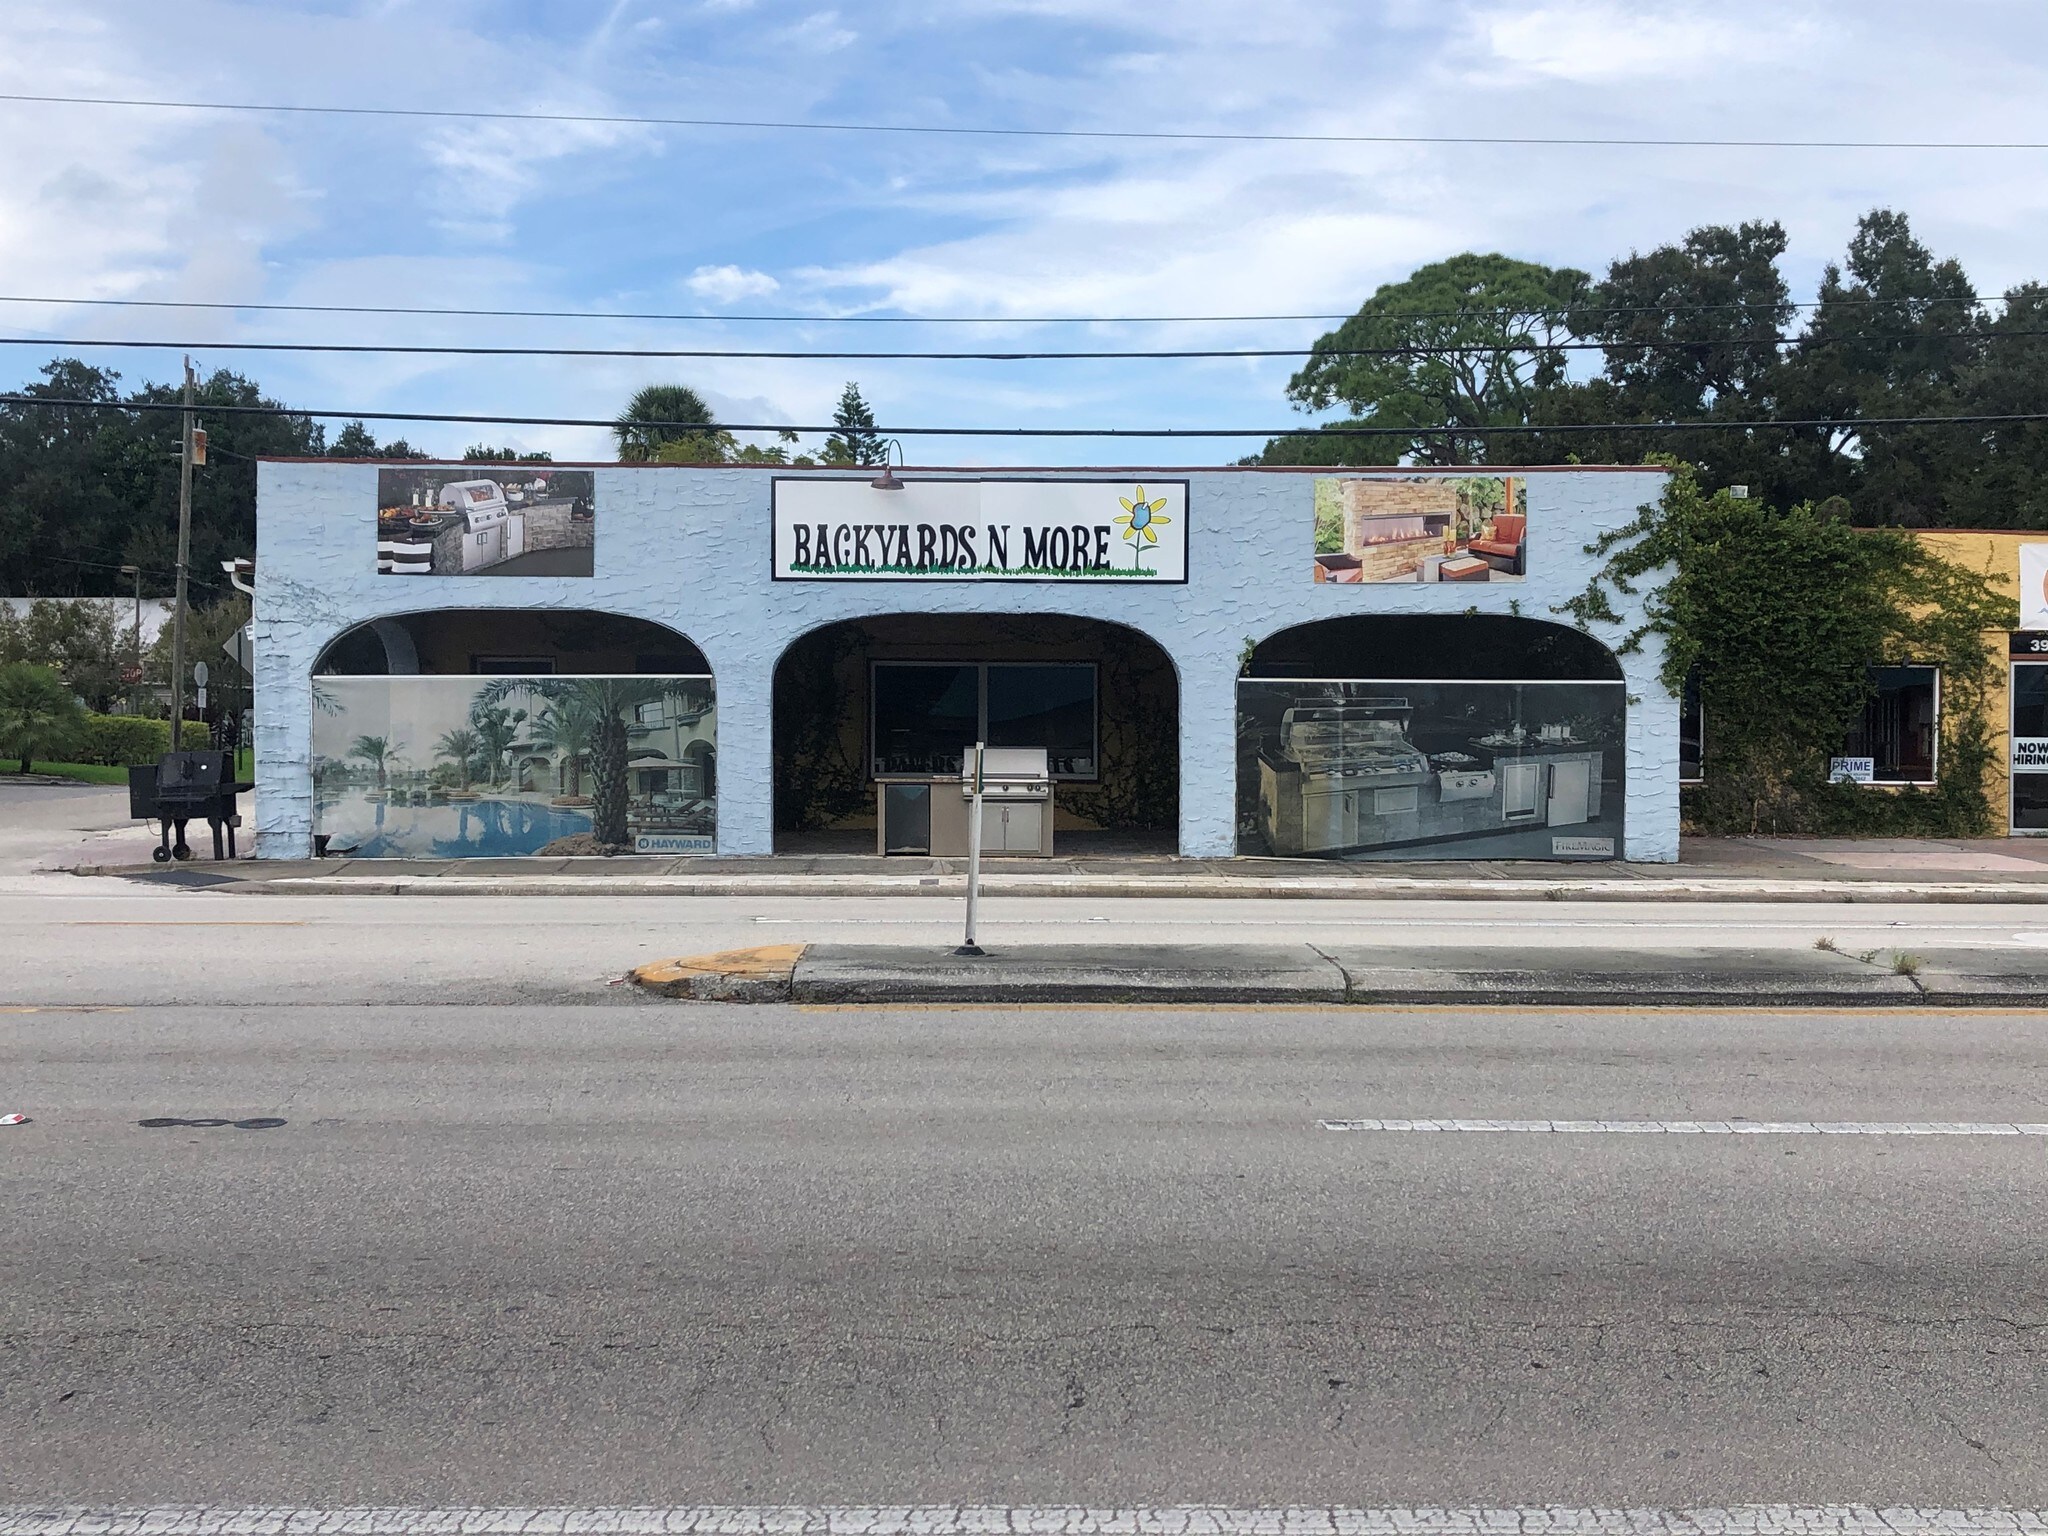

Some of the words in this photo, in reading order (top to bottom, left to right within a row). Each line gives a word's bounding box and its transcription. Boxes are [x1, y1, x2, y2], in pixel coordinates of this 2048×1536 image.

[793, 523, 977, 570] BACKYARDS
[986, 525, 1010, 570] N
[1021, 525, 1111, 570] MORE
[122, 668, 142, 678] TOP
[2017, 742, 2048, 753] NOW
[2013, 753, 2048, 765] HIRIN
[1832, 761, 1870, 772] PRIME
[651, 839, 711, 849] HAYWARD
